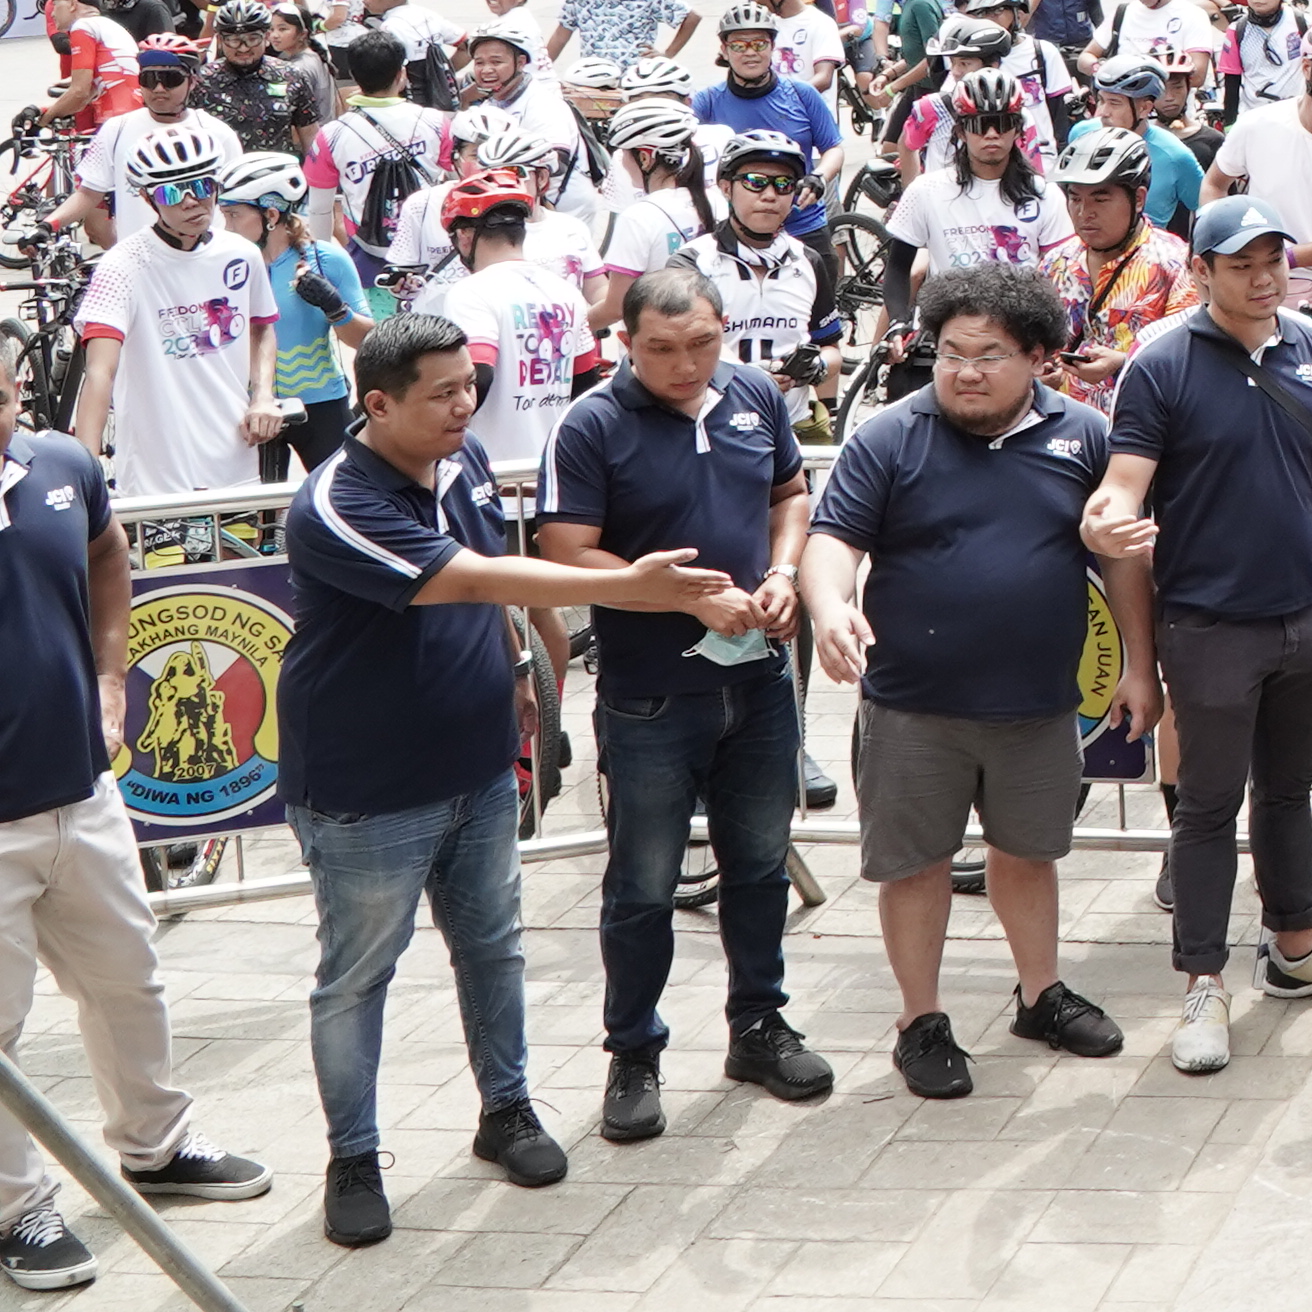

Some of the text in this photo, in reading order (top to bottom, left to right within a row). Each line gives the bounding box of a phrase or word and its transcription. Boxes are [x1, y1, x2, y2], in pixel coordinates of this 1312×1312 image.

[723, 317, 799, 333] SHIMANO
[1047, 439, 1070, 452] JCI
[45, 487, 67, 506] JCI
[127, 605, 286, 665] UNGSOD NG SA
[204, 623, 269, 668] MAYNILA
[1090, 642, 1112, 698] JUAN
[175, 762, 216, 780] 2007
[186, 790, 215, 805] NG
